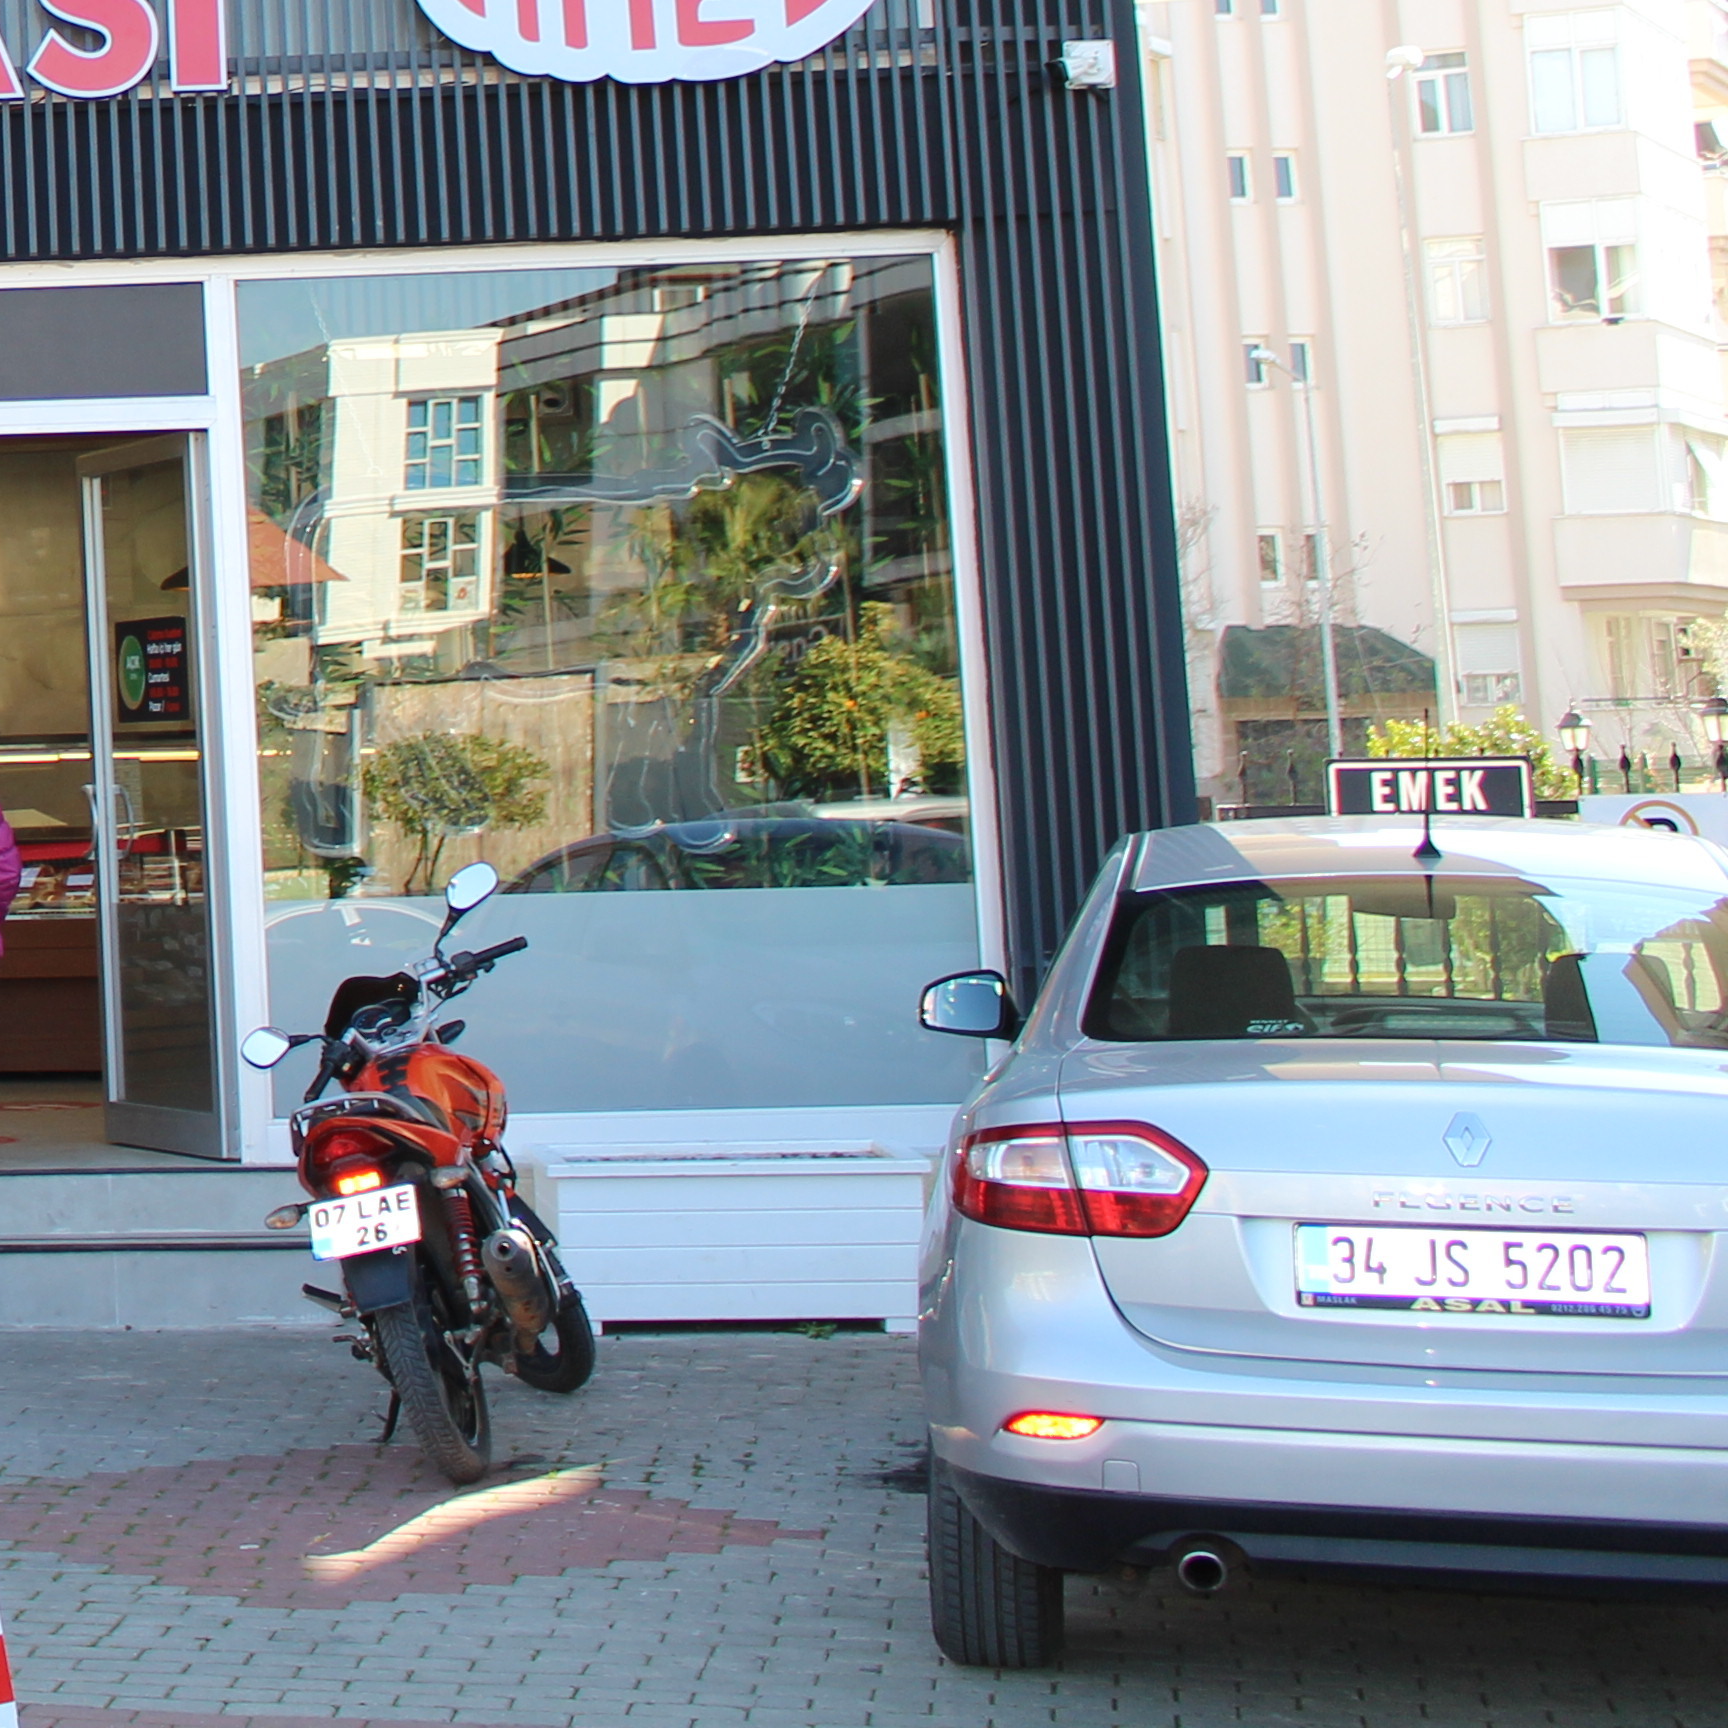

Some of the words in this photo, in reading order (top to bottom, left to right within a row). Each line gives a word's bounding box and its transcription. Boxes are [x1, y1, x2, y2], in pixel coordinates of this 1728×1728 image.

[1370, 770, 1489, 812] EMEK
[315, 1204, 346, 1228] 07
[357, 1191, 411, 1219] LAE
[1372, 1190, 1575, 1214] FLUENCE
[356, 1222, 388, 1246] 26
[1332, 1236, 1387, 1285] 34
[1414, 1238, 1470, 1287] JS
[1503, 1241, 1628, 1294] 5202
[1410, 1297, 1536, 1314] ASAL
